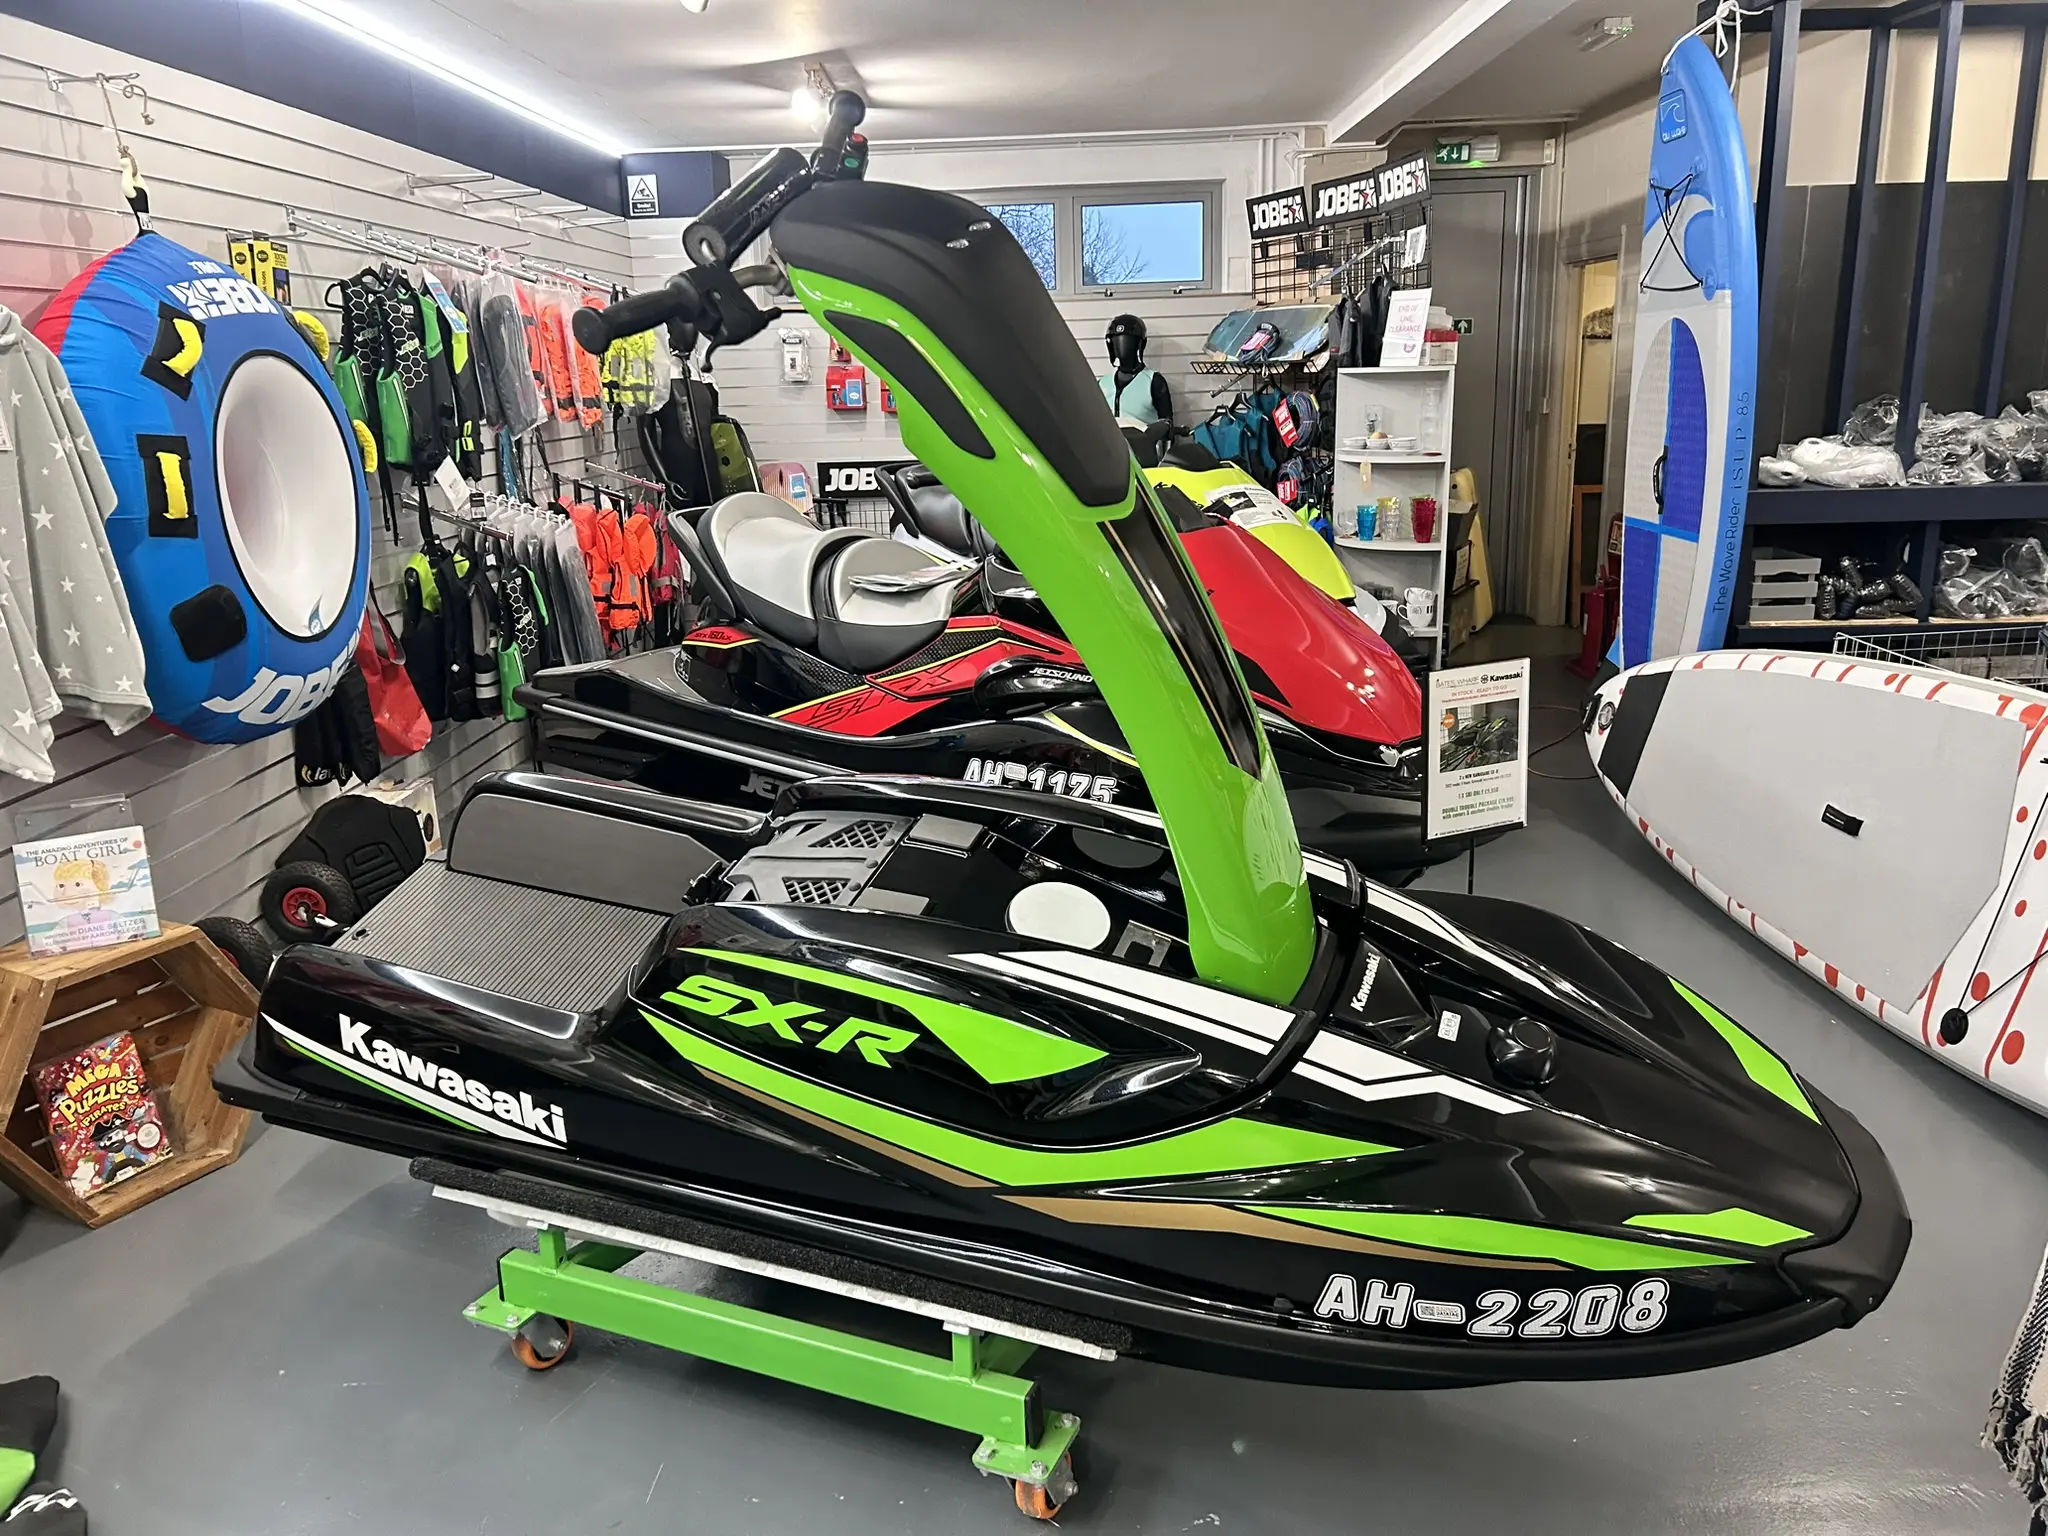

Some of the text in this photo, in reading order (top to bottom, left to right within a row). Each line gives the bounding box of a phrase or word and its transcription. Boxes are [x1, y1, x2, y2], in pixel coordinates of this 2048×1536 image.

[1316, 182, 1362, 219] JOBE
[1378, 162, 1412, 205] JOBE
[1252, 198, 1290, 232] JOBE
[824, 467, 897, 492] JOB
[1712, 585, 1728, 614] The
[1737, 391, 1751, 416] 85
[1028, 667, 1094, 683] JETSOUND
[1489, 671, 1523, 682] Kawasaki
[26, 850, 39, 858] THE
[40, 845, 73, 856] AMAZING
[73, 839, 119, 850] ADVENTURES
[33, 844, 128, 868] BOAT GIRL
[77, 925, 105, 935] DIANE
[107, 917, 146, 930] SELTZER
[1349, 951, 1381, 1013] Kawasaki
[659, 974, 921, 1069] SX-R
[65, 1062, 122, 1097] MEGA
[338, 1012, 568, 1143] Kawasaki
